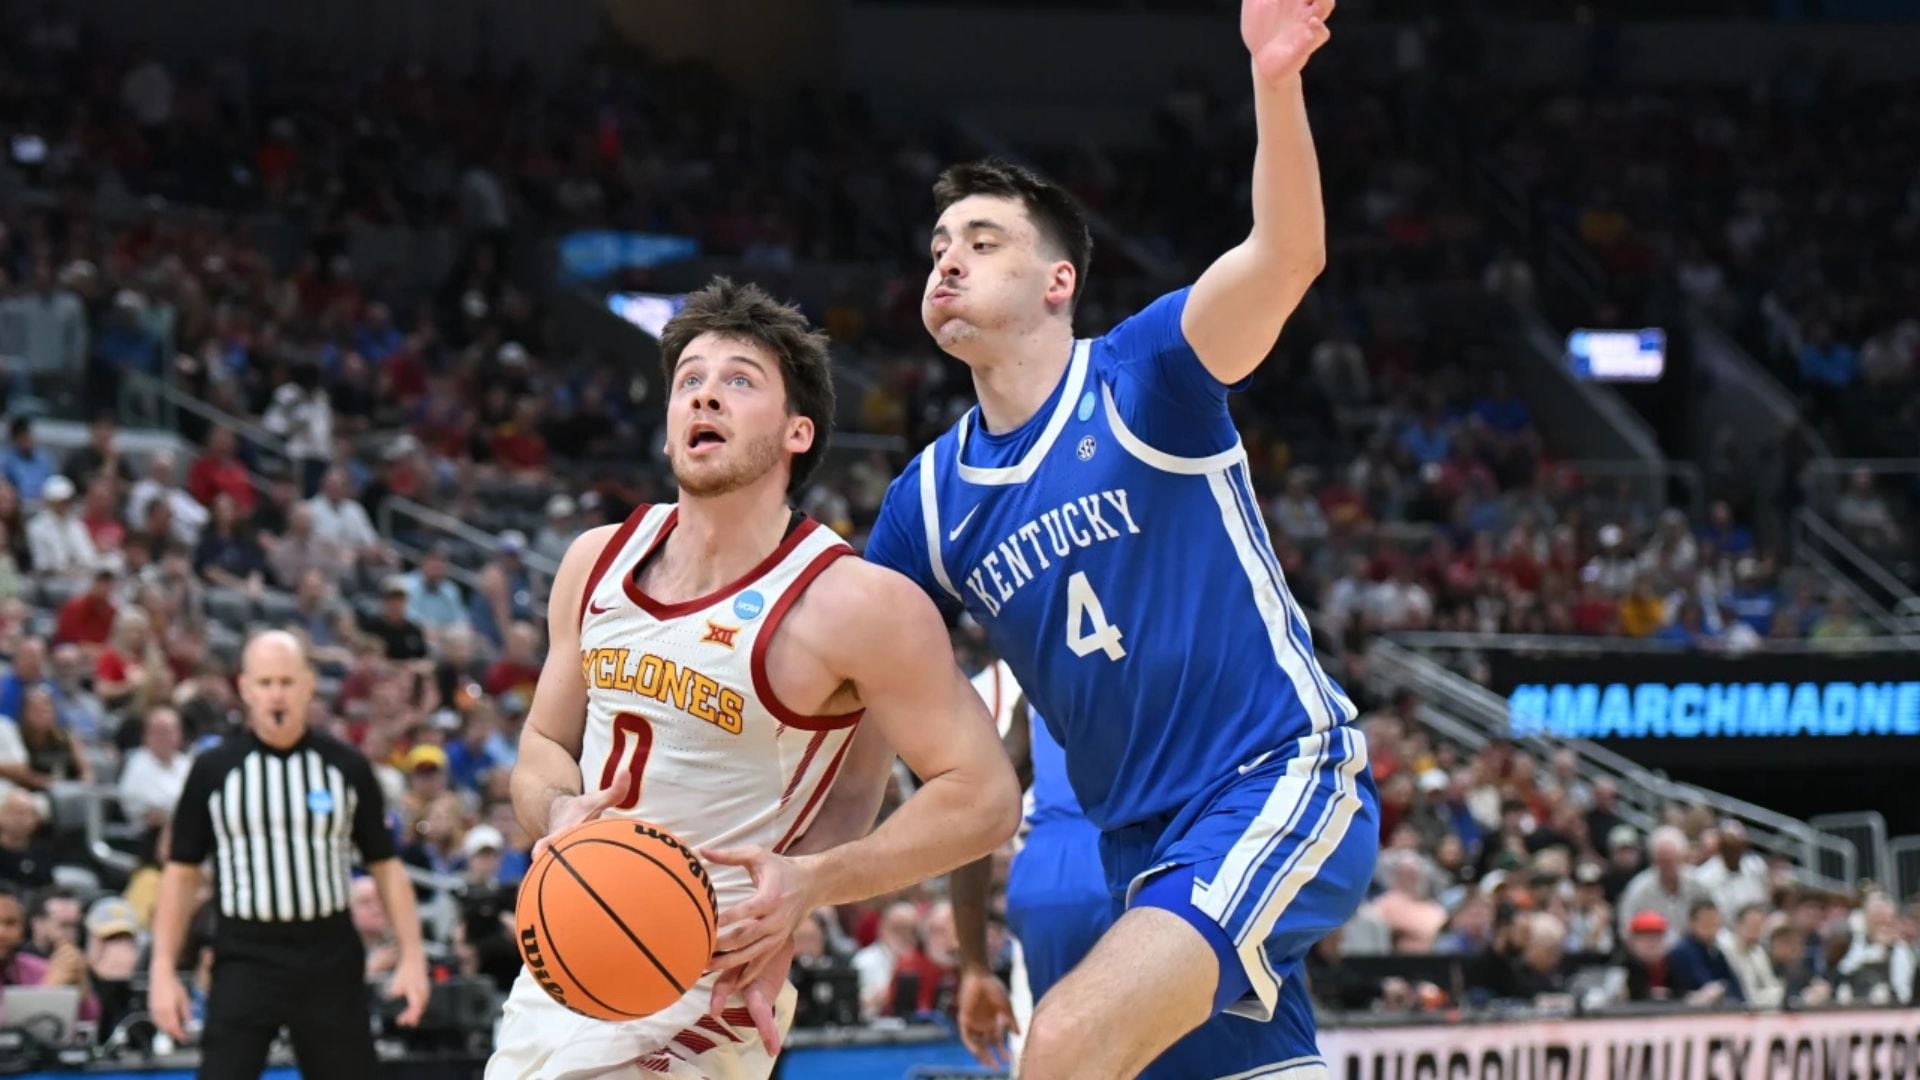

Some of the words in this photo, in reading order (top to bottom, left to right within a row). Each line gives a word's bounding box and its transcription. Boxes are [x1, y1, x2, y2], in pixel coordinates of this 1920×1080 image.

[966, 488, 1141, 617] KENTUCKY
[1066, 571, 1127, 661] 4
[581, 647, 744, 735] YCLONES
[600, 711, 652, 810] 0
[521, 924, 598, 1018] Wils
